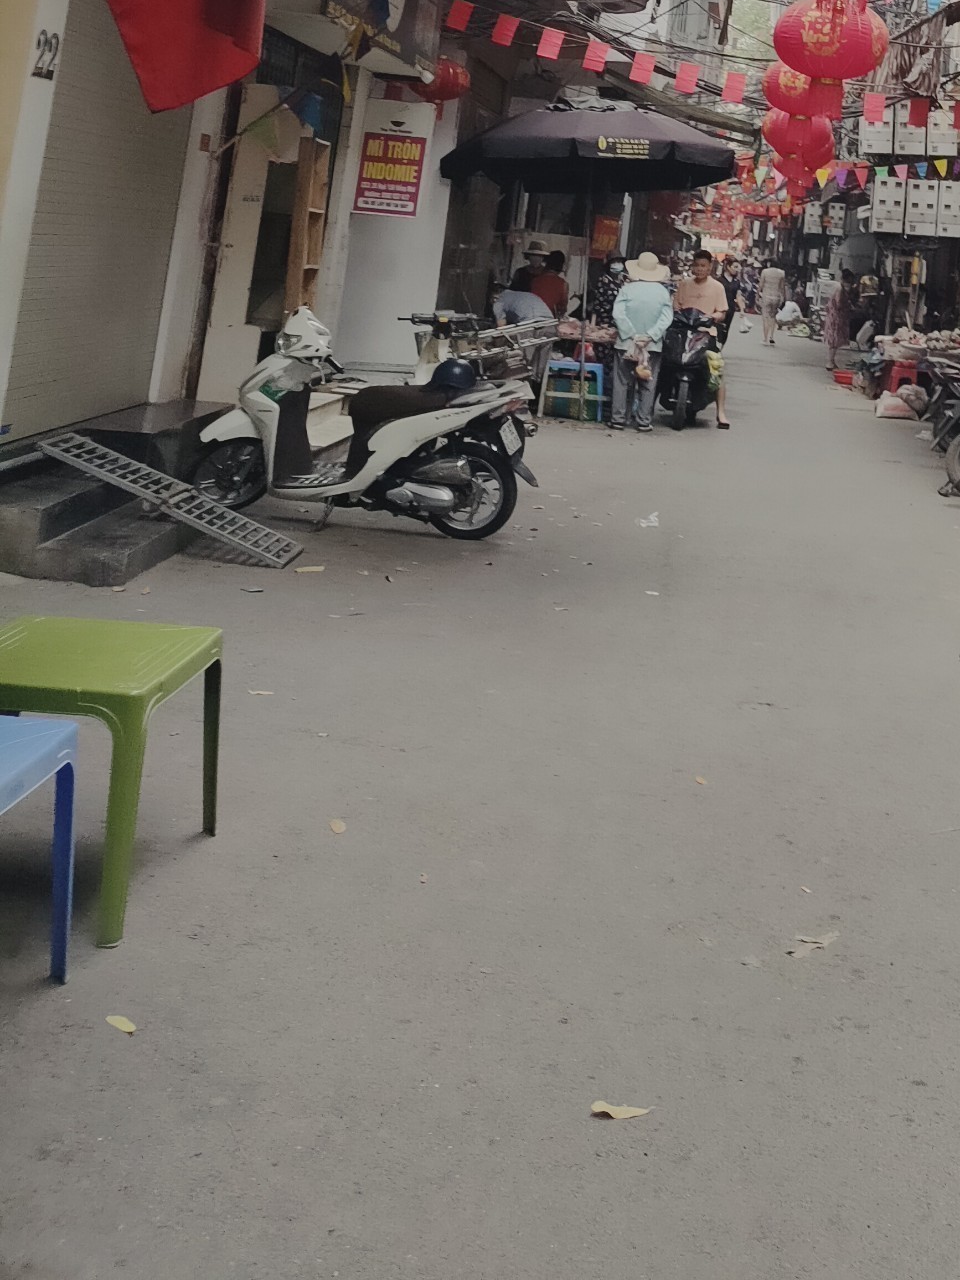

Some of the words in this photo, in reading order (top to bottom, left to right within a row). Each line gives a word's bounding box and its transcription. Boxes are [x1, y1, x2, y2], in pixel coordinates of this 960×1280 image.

[31, 29, 60, 81] 22
[366, 136, 385, 157] MÌ
[362, 160, 419, 183] INDOMIE
